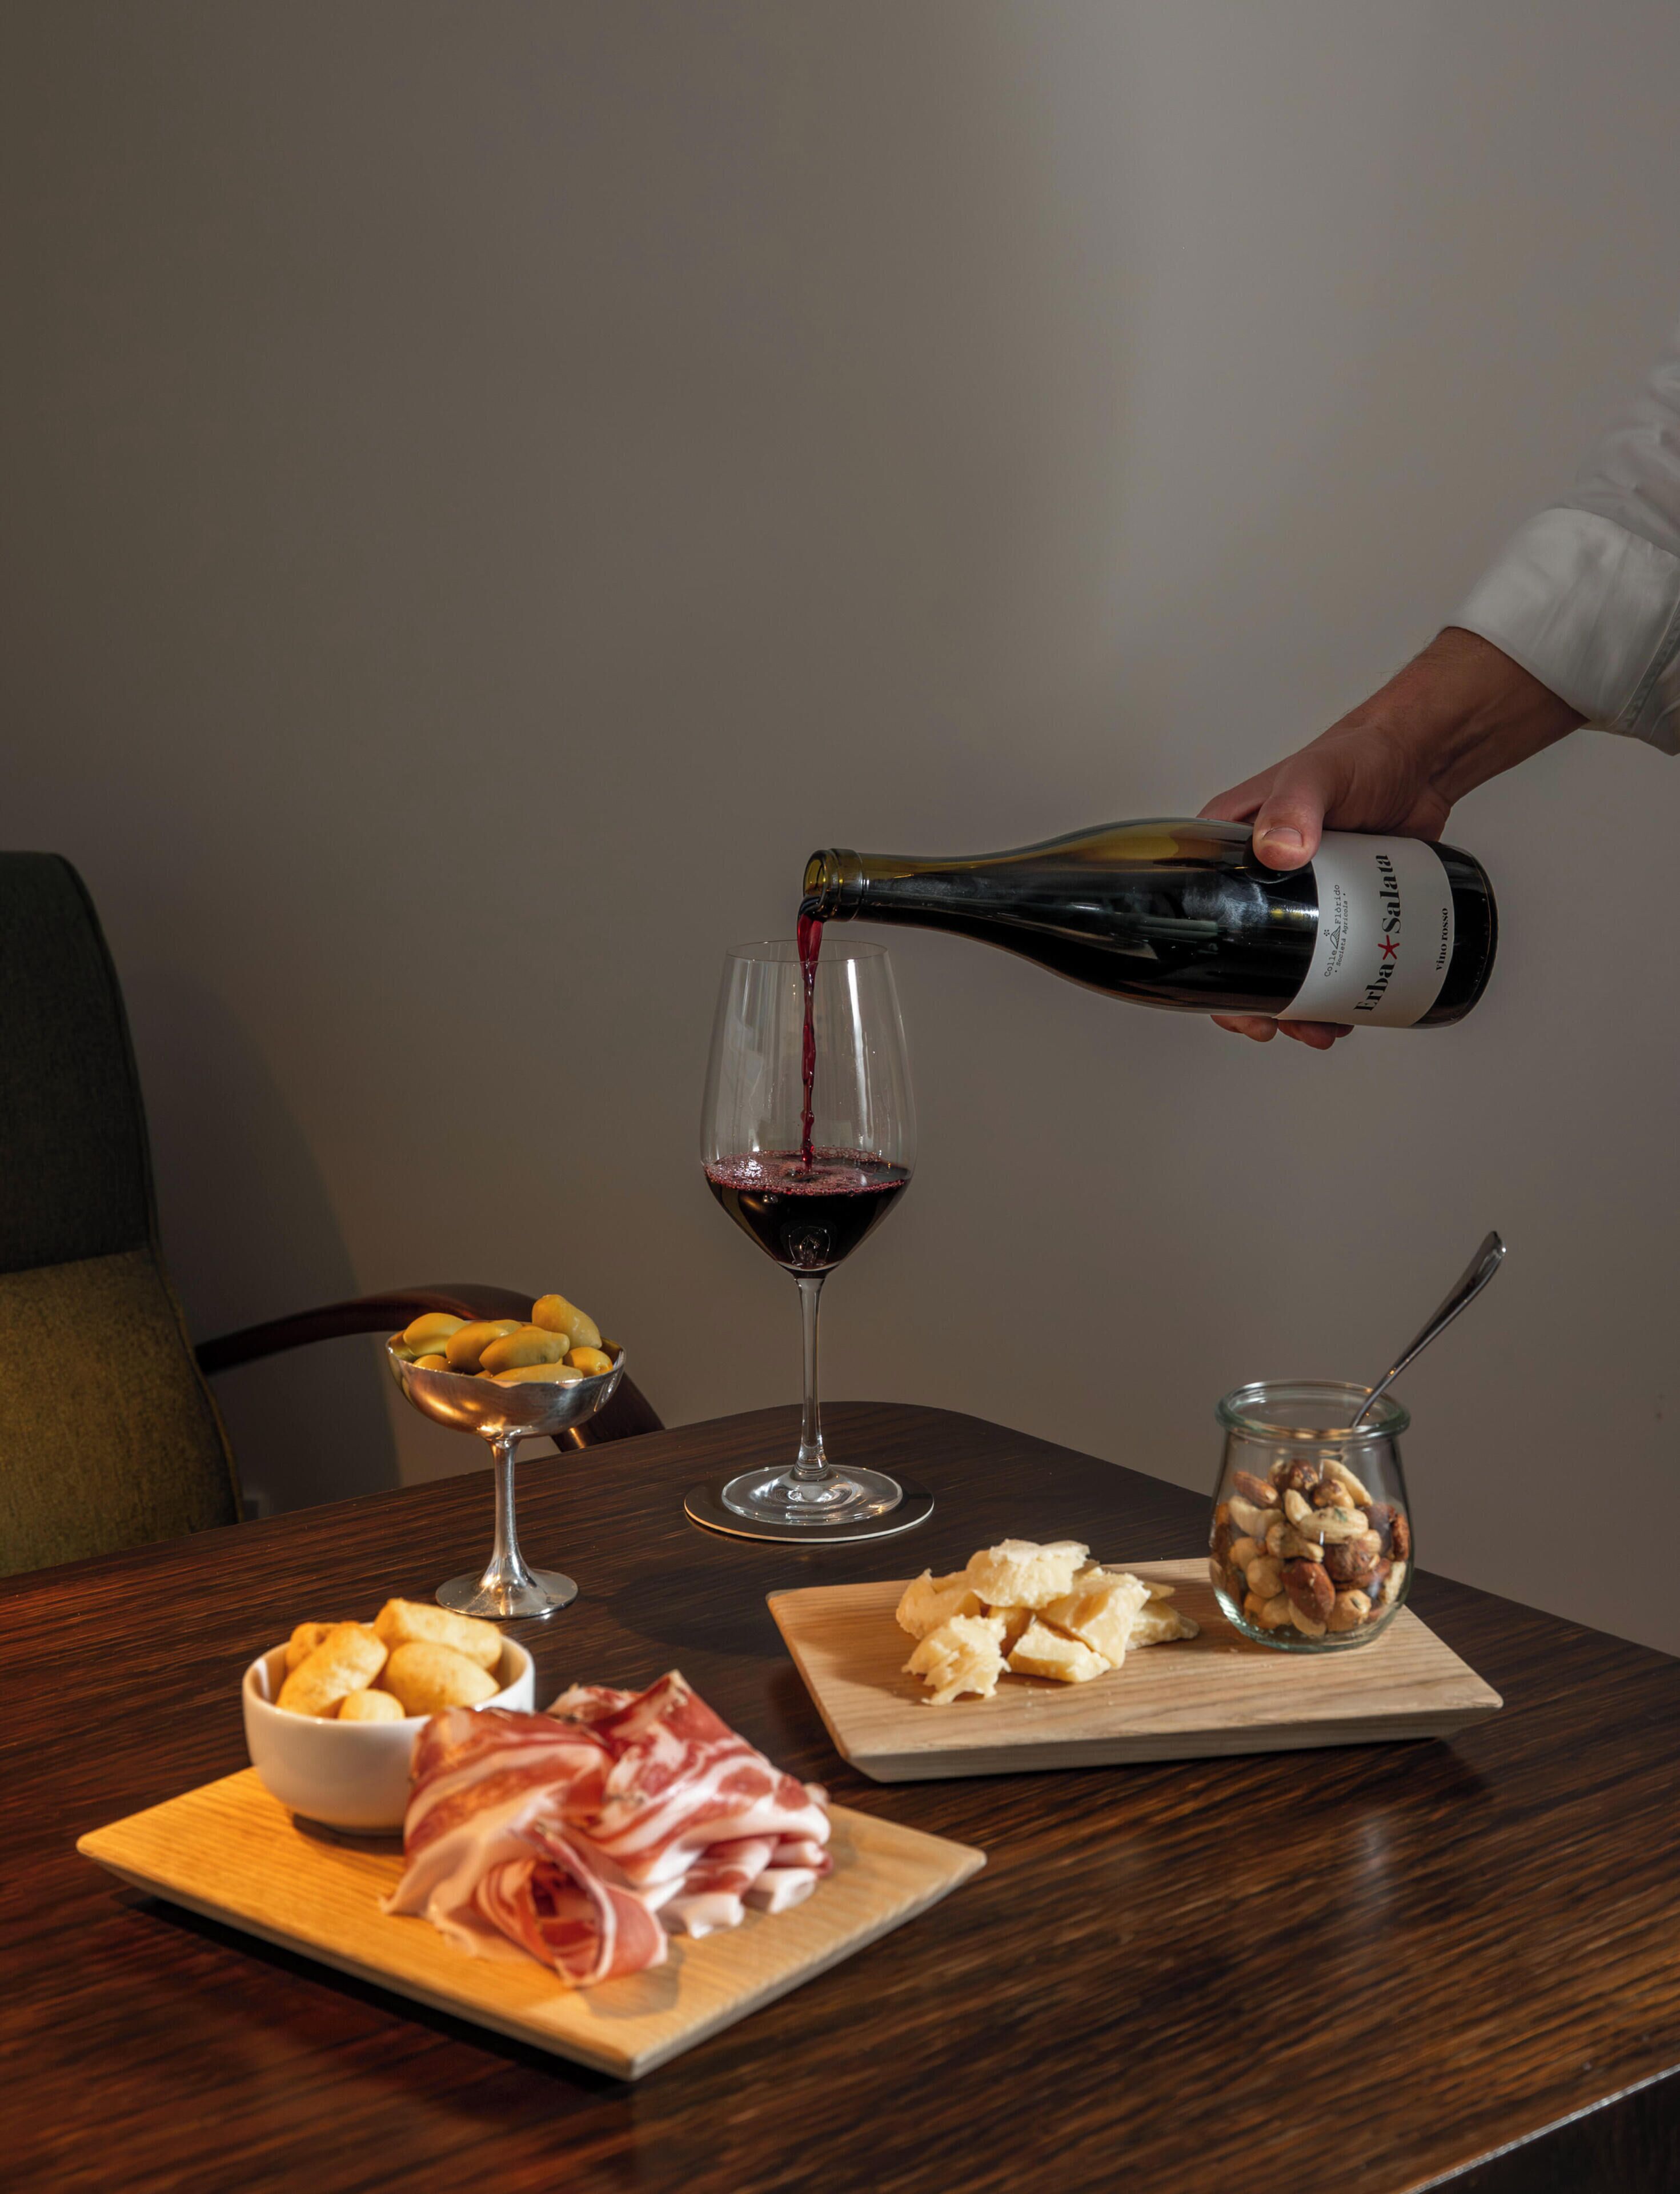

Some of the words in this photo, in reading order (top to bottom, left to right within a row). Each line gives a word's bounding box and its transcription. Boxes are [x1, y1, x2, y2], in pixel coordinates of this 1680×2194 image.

[1353, 963, 1396, 1011] Erba
[1375, 854, 1401, 934] Salata
[1324, 950, 1337, 977] Colle
[1436, 943, 1448, 971] vino
